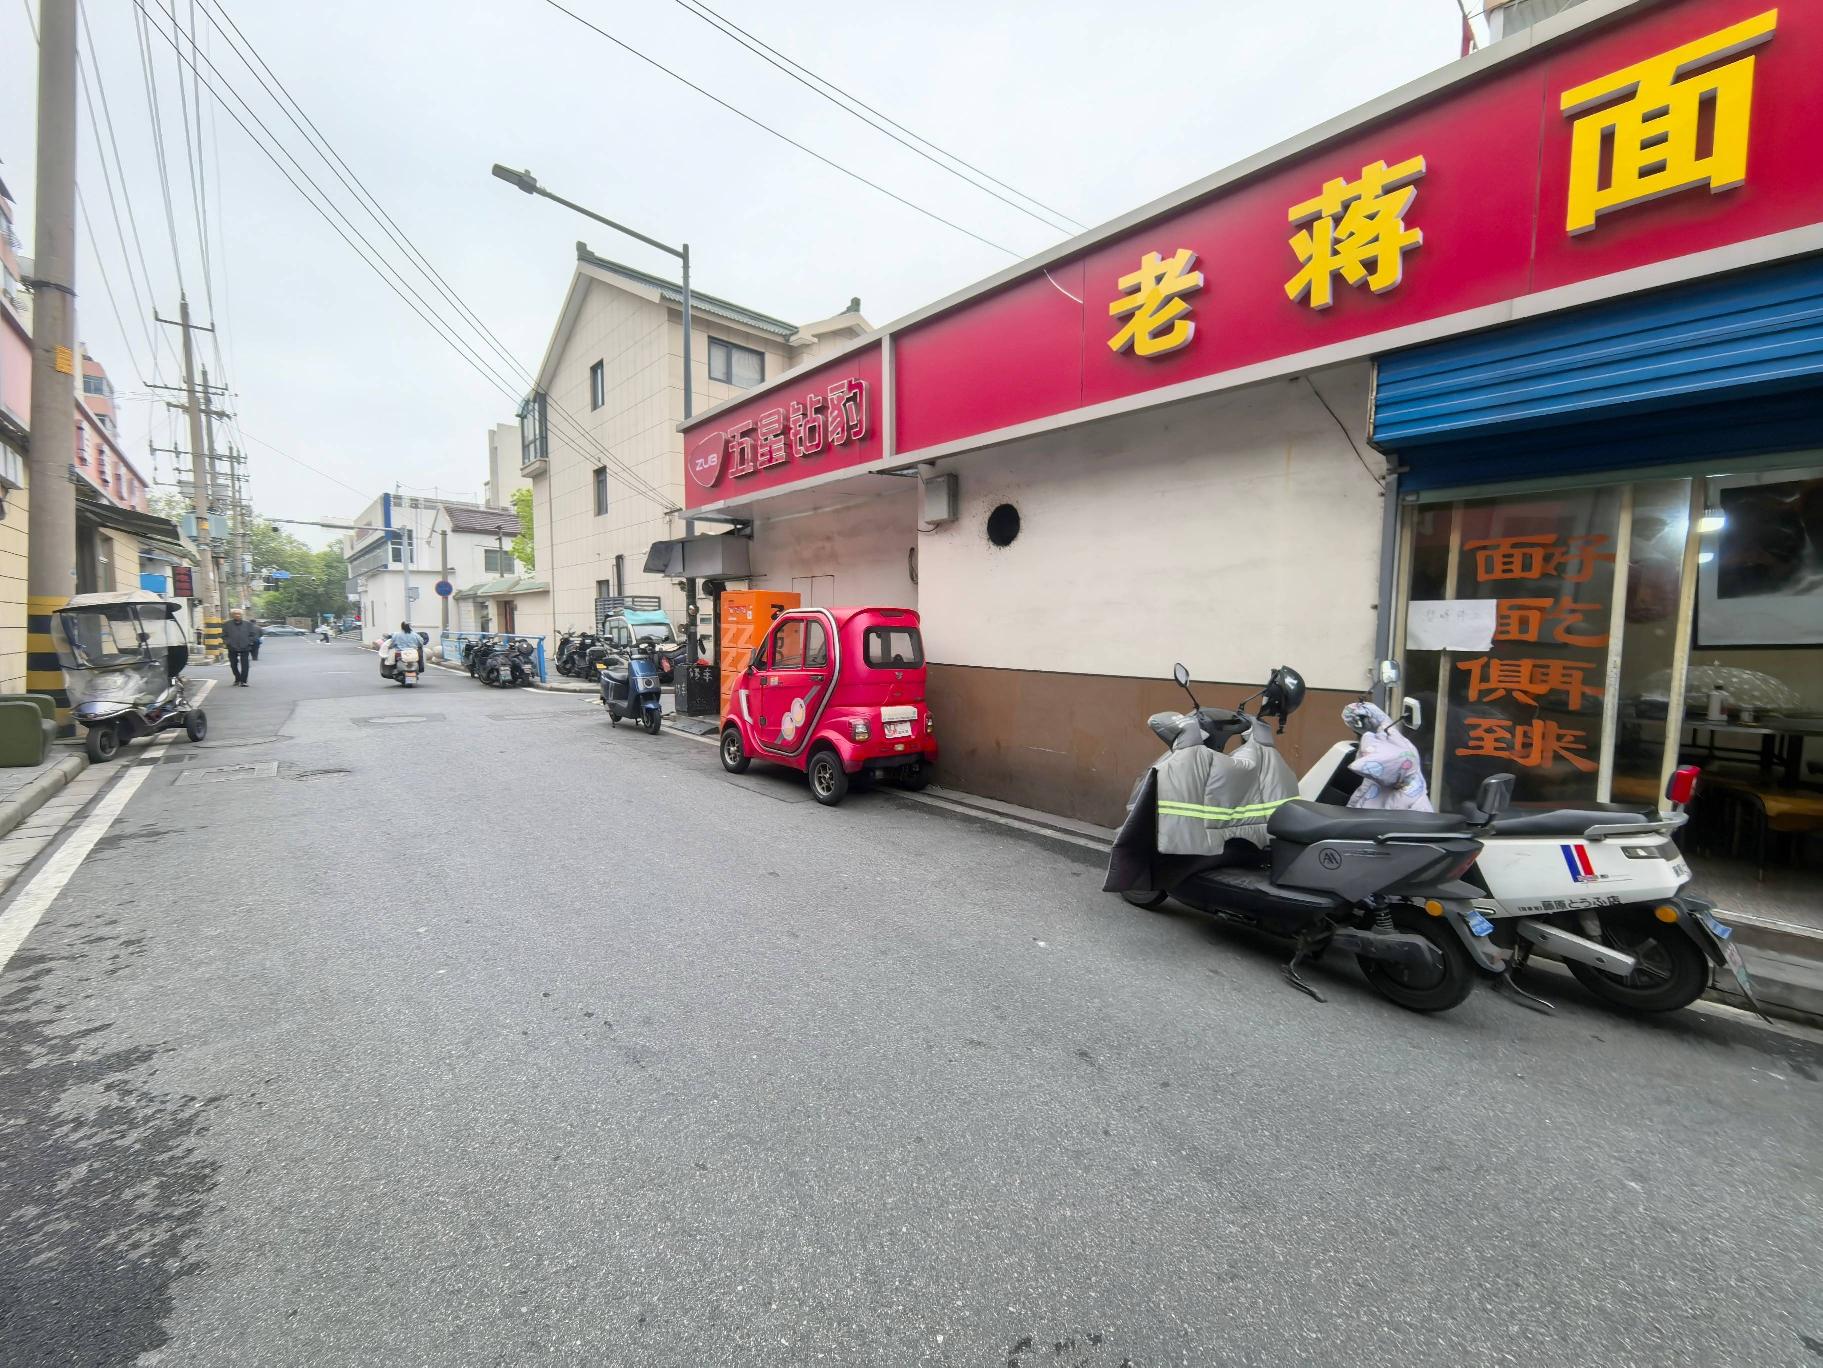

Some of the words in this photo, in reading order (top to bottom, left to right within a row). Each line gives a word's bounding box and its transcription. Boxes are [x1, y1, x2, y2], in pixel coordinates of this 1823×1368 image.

[1106, 8, 1778, 357] 老蒋面
[727, 378, 870, 479] 五星钻豹
